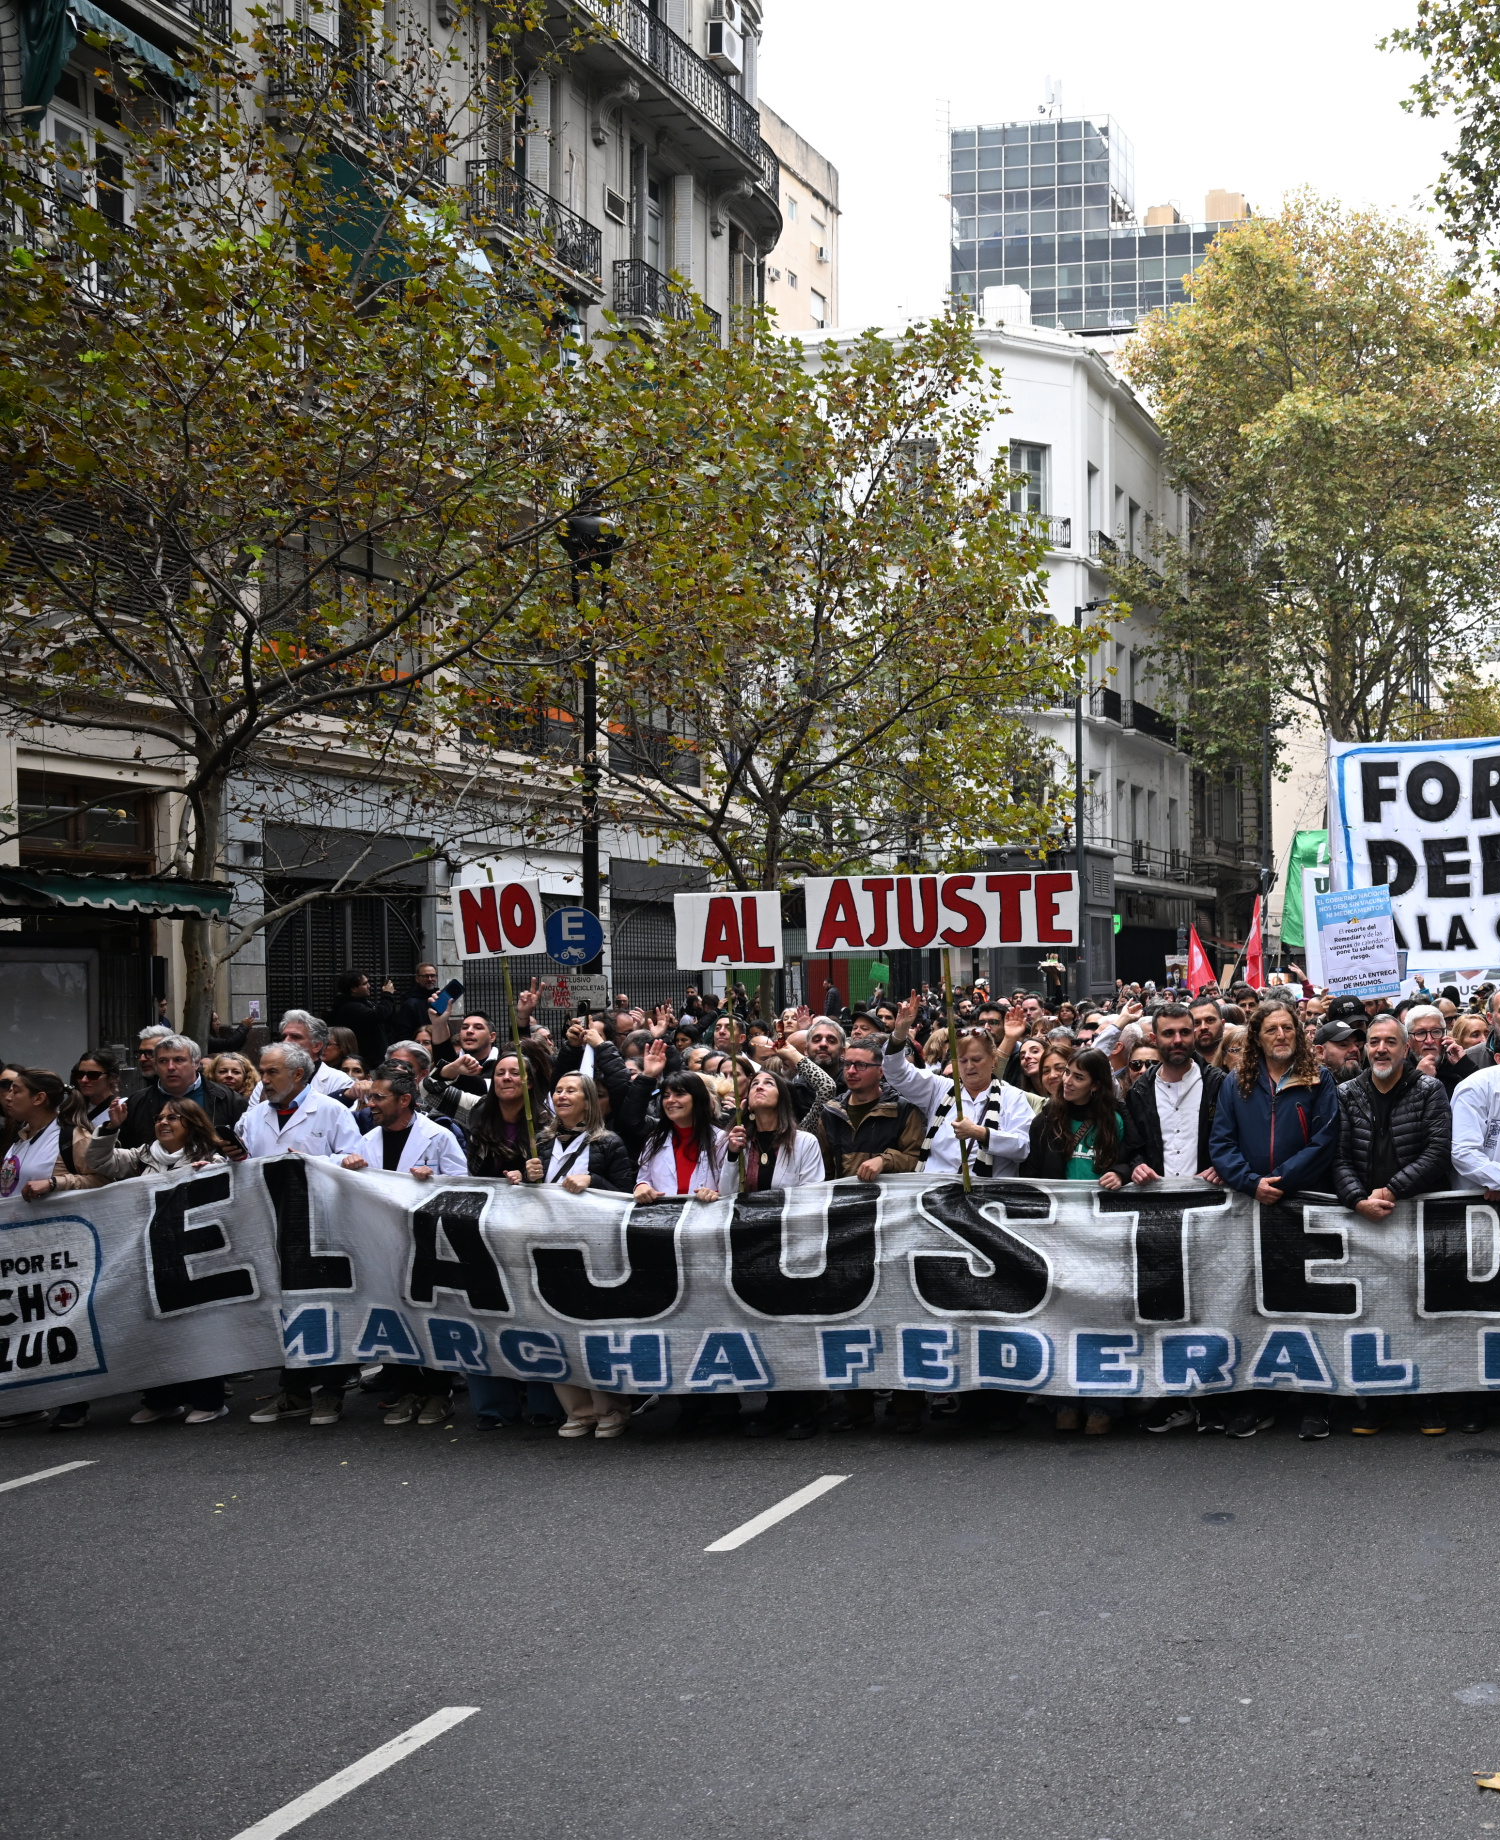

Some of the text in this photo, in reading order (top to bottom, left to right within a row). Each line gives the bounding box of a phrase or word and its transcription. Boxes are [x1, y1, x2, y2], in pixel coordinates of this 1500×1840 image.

[1325, 895, 1357, 904] GOBIERNO
[1360, 897, 1390, 906] VACUNAS
[816, 873, 1073, 949] AJUSTE
[1334, 904, 1384, 917] MEDICAMENTOS
[459, 883, 537, 955] NO
[561, 911, 586, 941] E
[702, 896, 775, 963] AL
[1345, 926, 1366, 934] recorte
[1334, 934, 1361, 943] Remediar
[1360, 944, 1375, 952] salud
[556, 976, 591, 984] EXCLUSIVO
[1328, 974, 1358, 984] EXIGIMOS
[1368, 969, 1398, 978] ENTREGA
[1353, 979, 1384, 988] INSUMOS.
[146, 1154, 355, 1319] EL
[403, 1181, 1362, 1323] AJUSTE
[1, 1251, 78, 1278] POR EL
[279, 1302, 771, 1391] MARCHA
[817, 1324, 1417, 1391] FEDERAL
